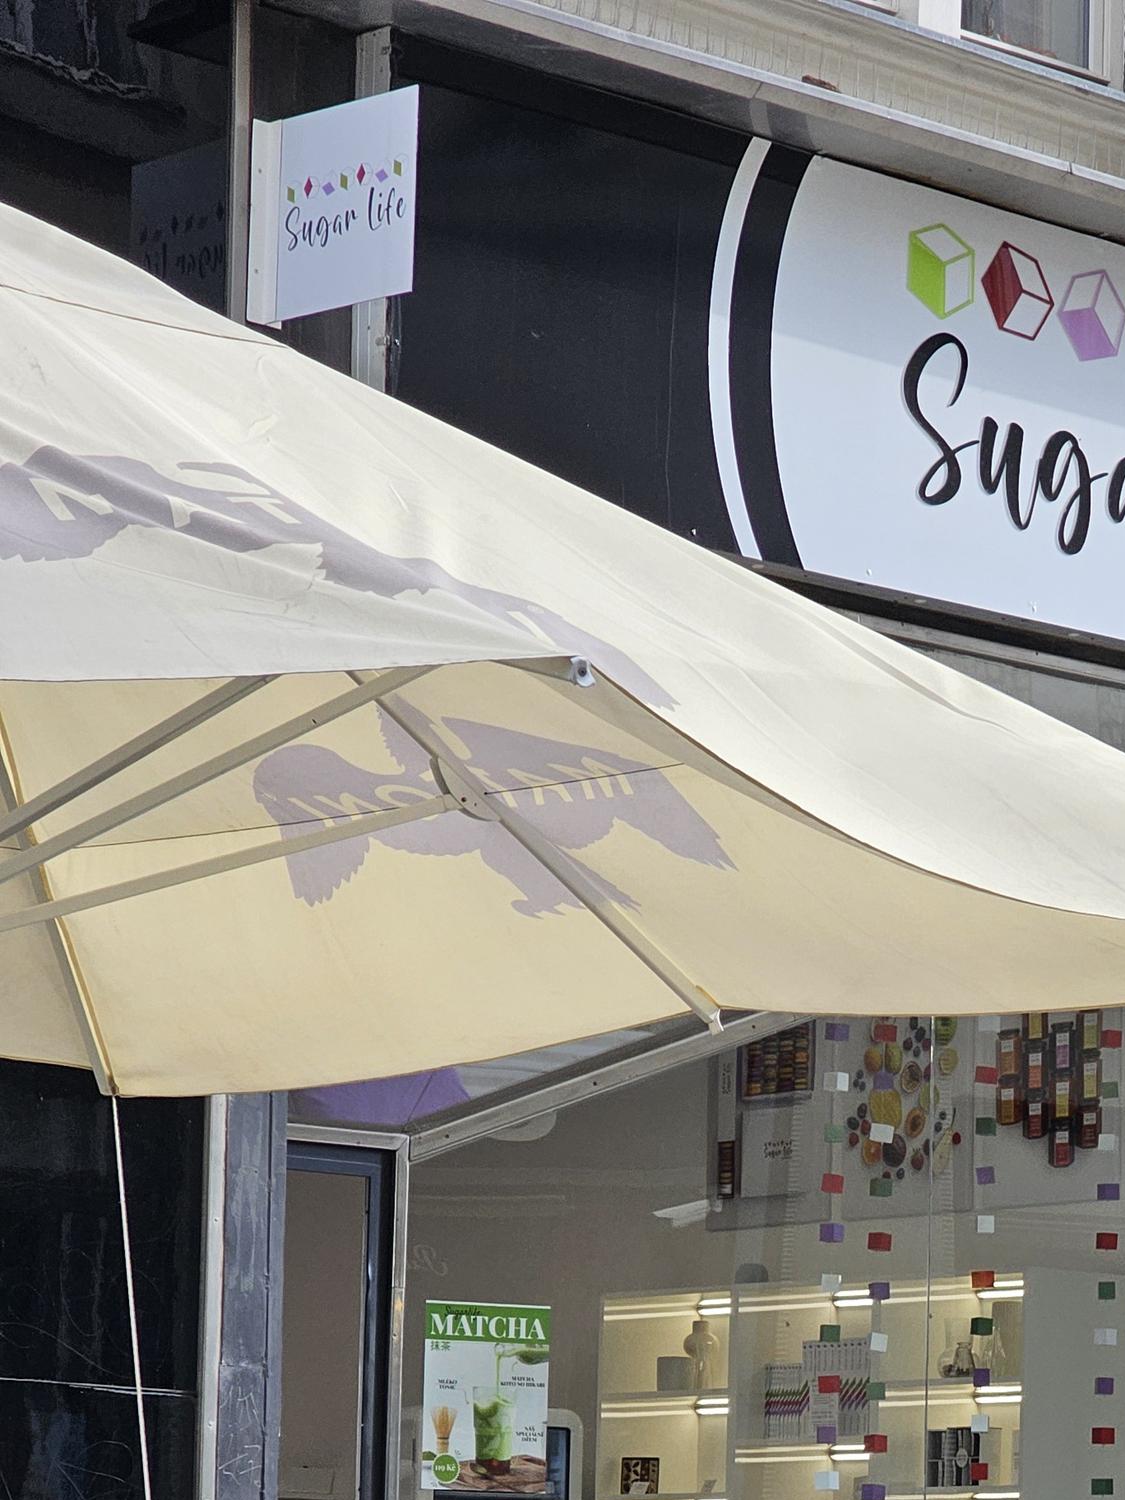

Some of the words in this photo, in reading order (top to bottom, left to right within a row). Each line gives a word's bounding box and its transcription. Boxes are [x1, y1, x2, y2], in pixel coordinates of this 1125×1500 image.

[285, 206, 359, 251] Sugar
[367, 187, 407, 231] Life
[430, 1313, 546, 1340] MATCHA
